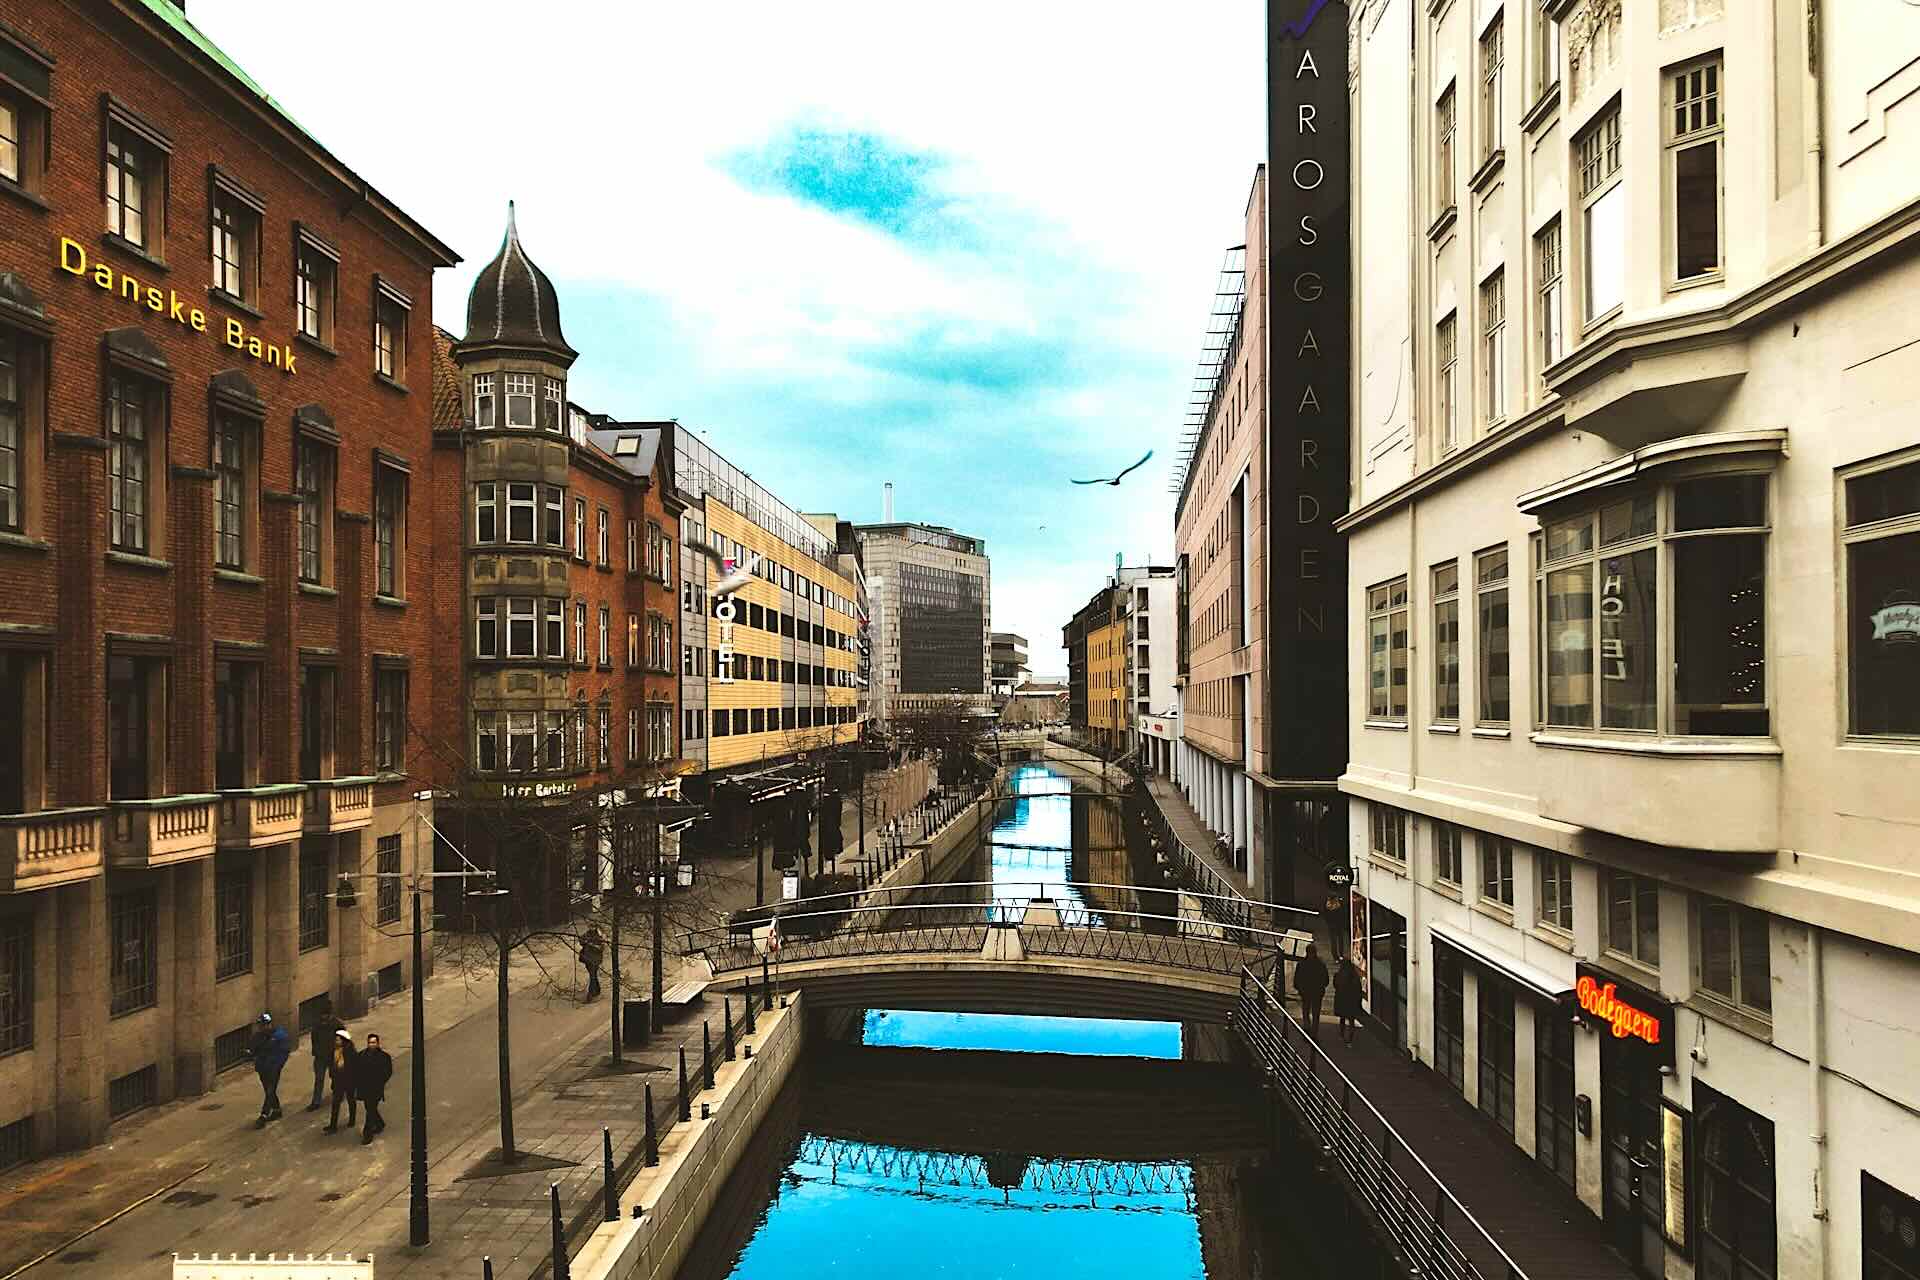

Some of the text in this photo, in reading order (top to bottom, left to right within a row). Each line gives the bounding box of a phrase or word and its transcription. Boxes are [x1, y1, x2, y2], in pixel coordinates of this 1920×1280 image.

[60, 236, 297, 375] Danske Bank
[1577, 975, 1661, 1044] Bodegaen
